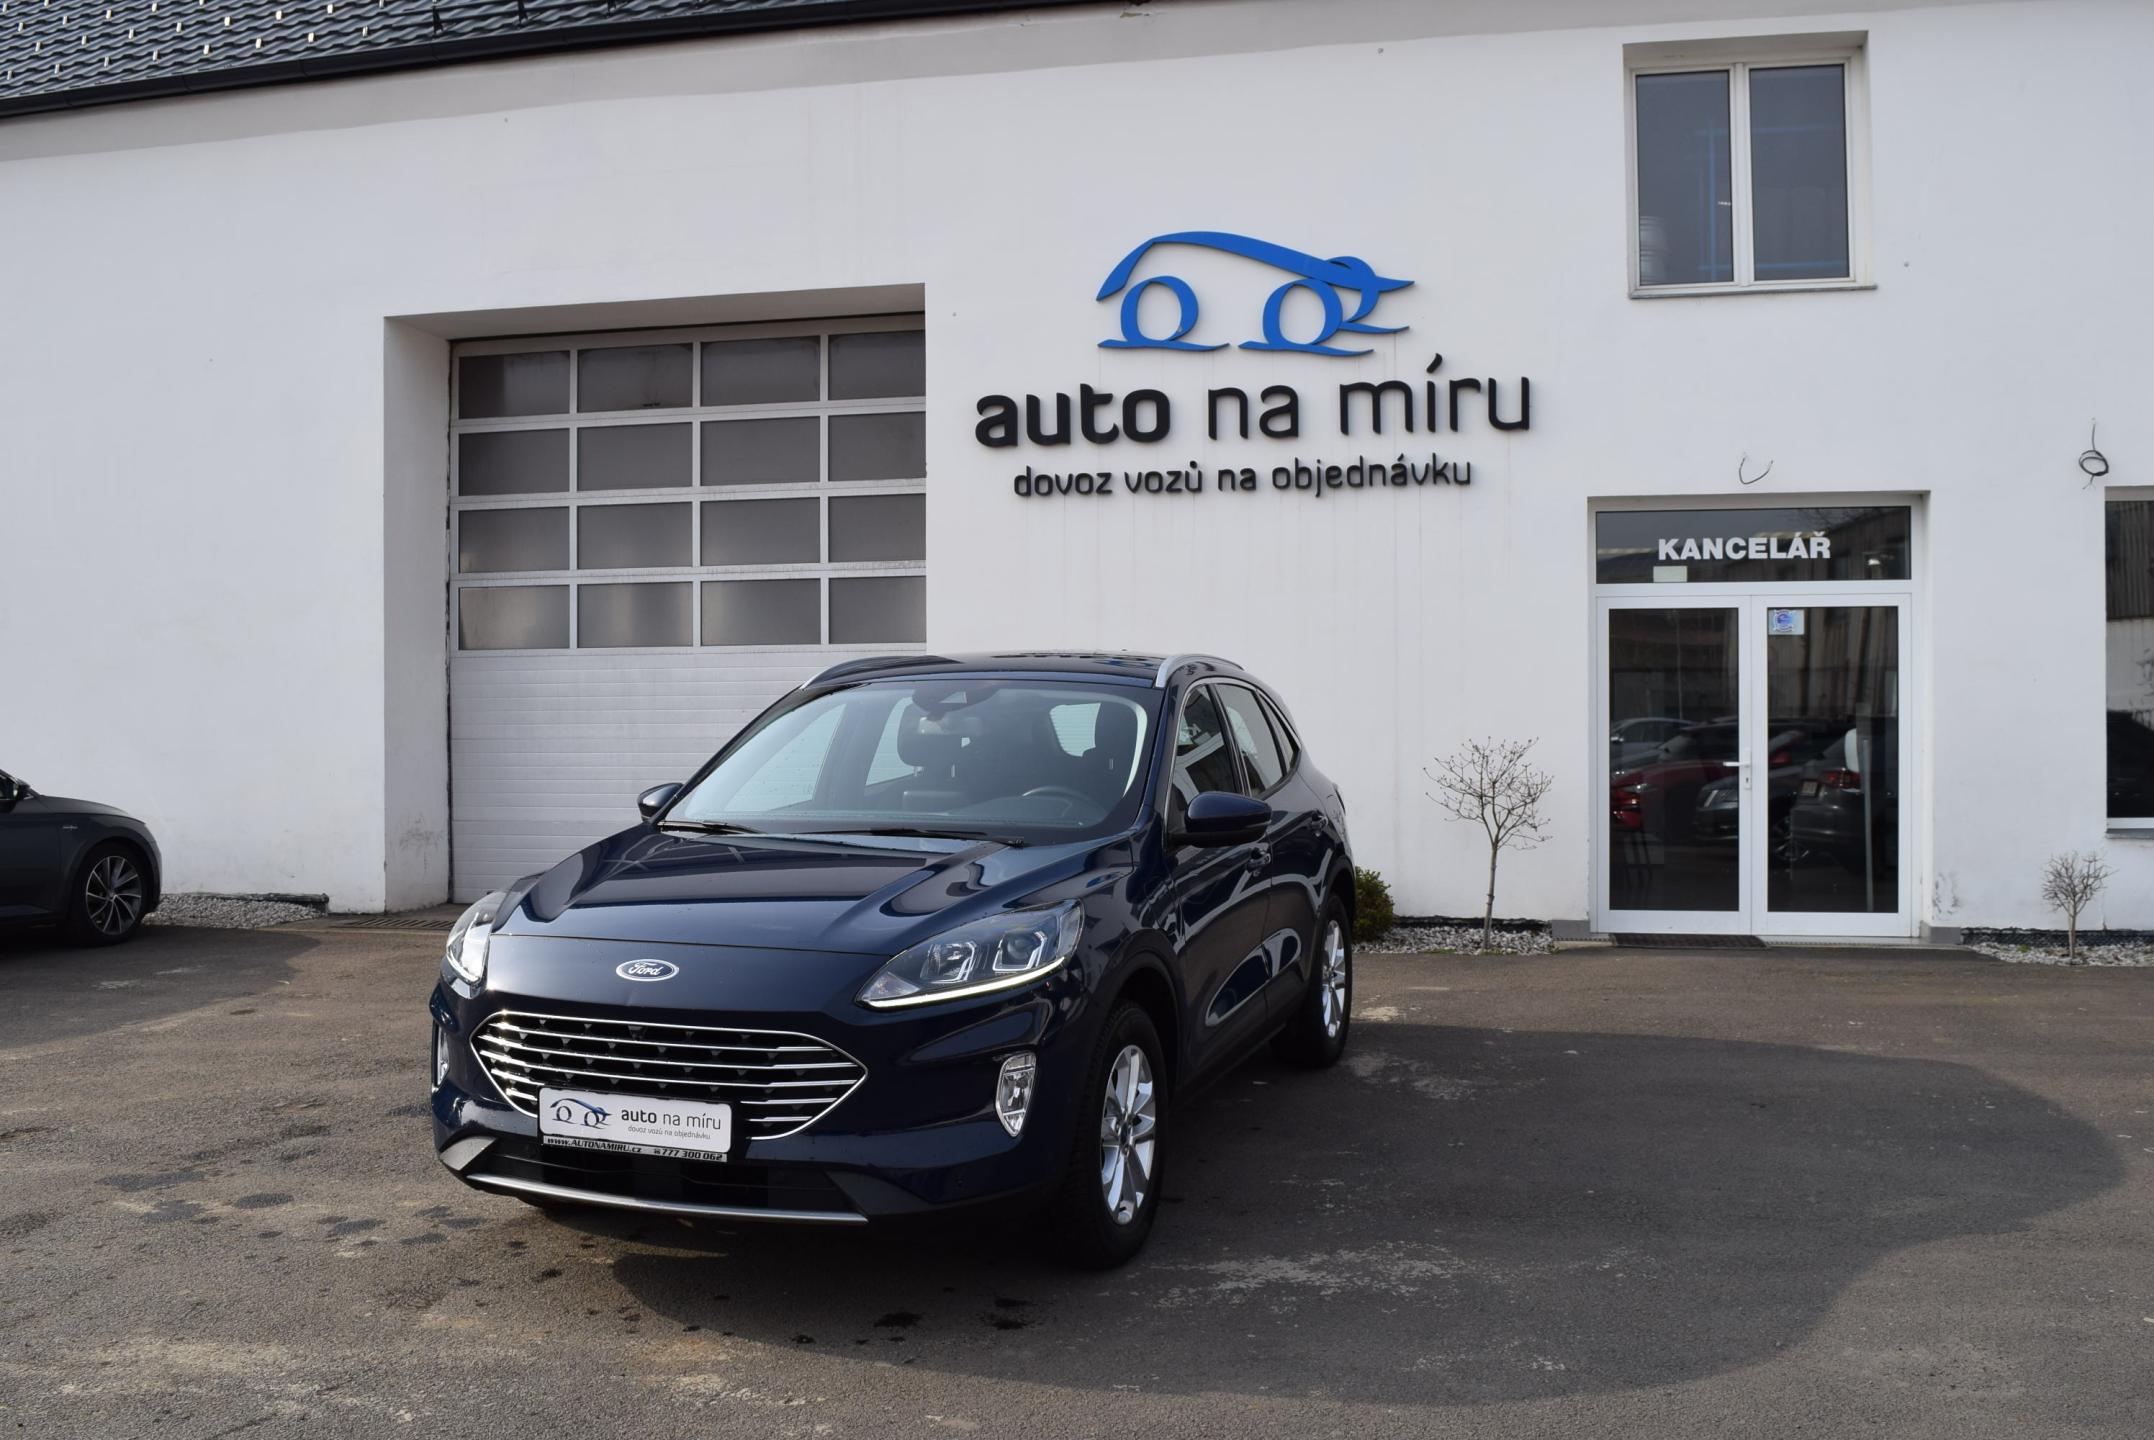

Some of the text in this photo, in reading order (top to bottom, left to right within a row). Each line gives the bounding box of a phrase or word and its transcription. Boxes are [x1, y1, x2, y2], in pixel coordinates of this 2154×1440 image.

[975, 353, 1530, 447] auto na míru
[1014, 453, 1471, 498] dovoz vozů na objednávku
[1658, 531, 1831, 560] KANCELÁŘ
[628, 961, 664, 976] Ford
[621, 1109, 721, 1130] auto na míru
[628, 1125, 646, 1134] dovoz
[674, 1129, 711, 1140] objednávku
[662, 1148, 680, 1157] 777
[682, 1150, 701, 1159] 300
